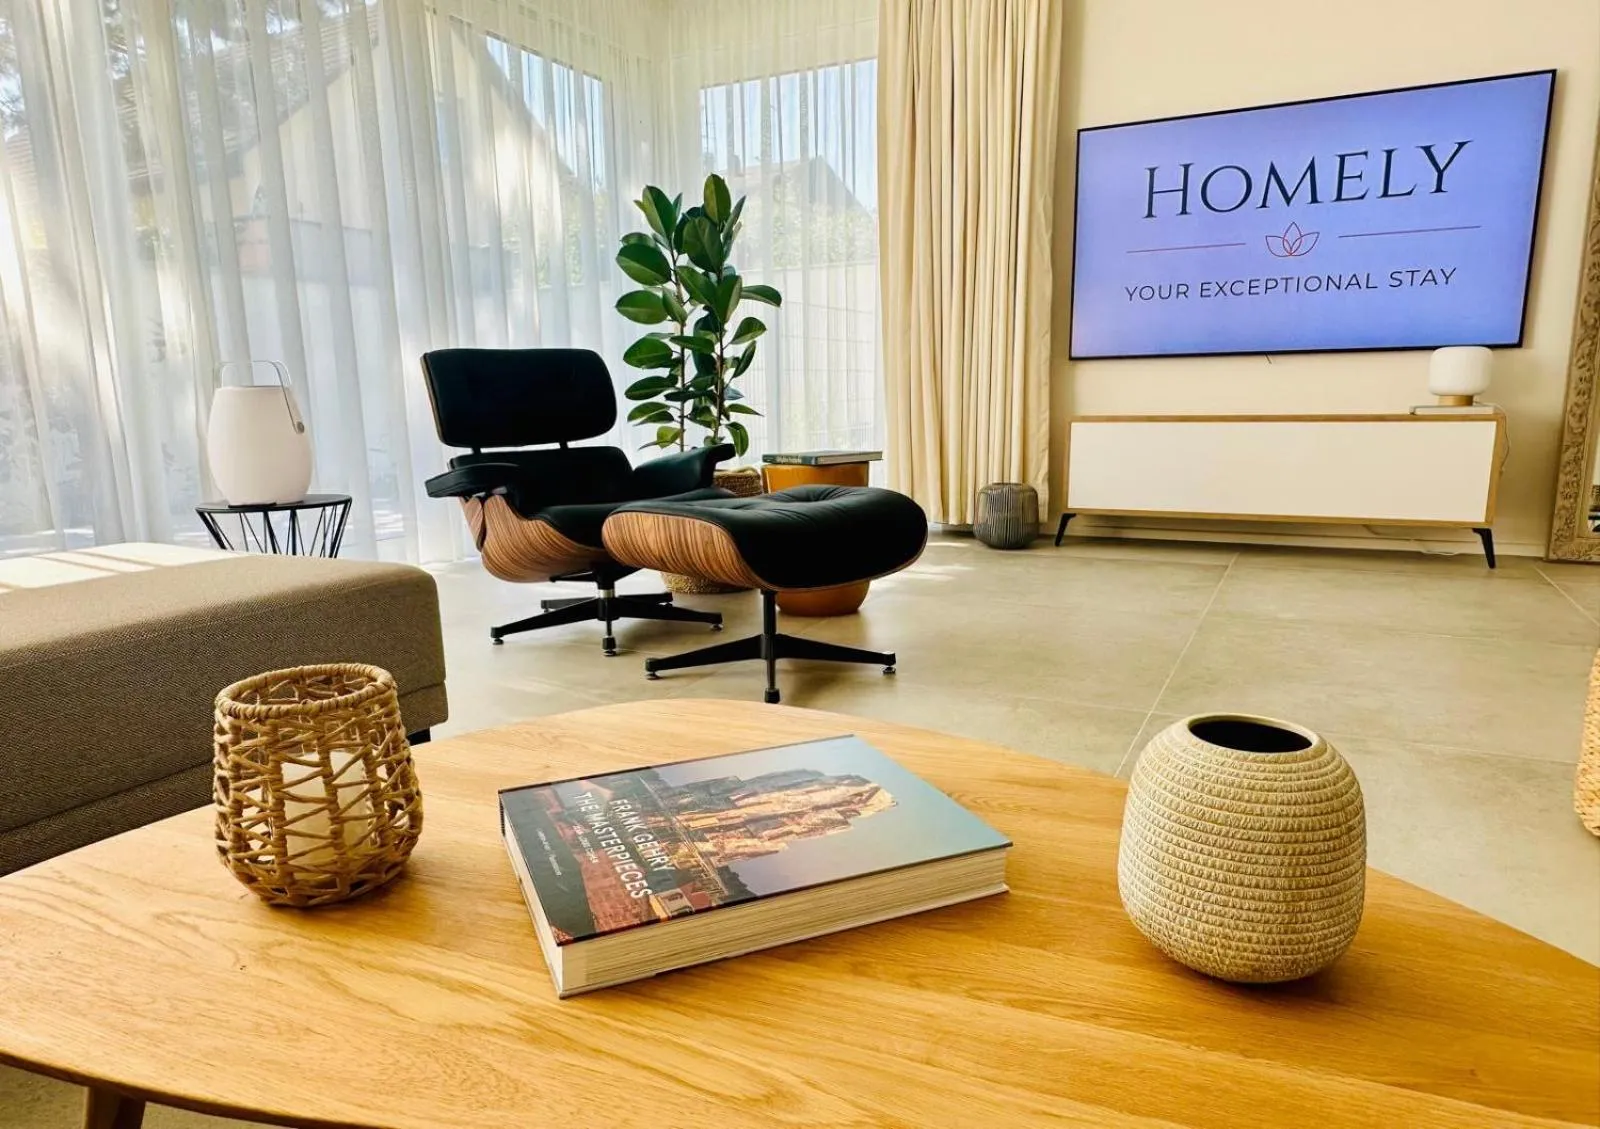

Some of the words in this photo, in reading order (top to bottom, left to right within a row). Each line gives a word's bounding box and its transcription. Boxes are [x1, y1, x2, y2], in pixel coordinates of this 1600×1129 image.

[1142, 140, 1473, 219] HOMELY
[1125, 283, 1190, 302] YOUR
[1200, 272, 1378, 298] EXCEPTIONAL
[1388, 266, 1457, 288] STAY
[572, 791, 600, 812] THE
[608, 799, 647, 833] FRANK
[633, 833, 676, 872] GEHRY
[585, 812, 653, 899] MASTERPIECES
